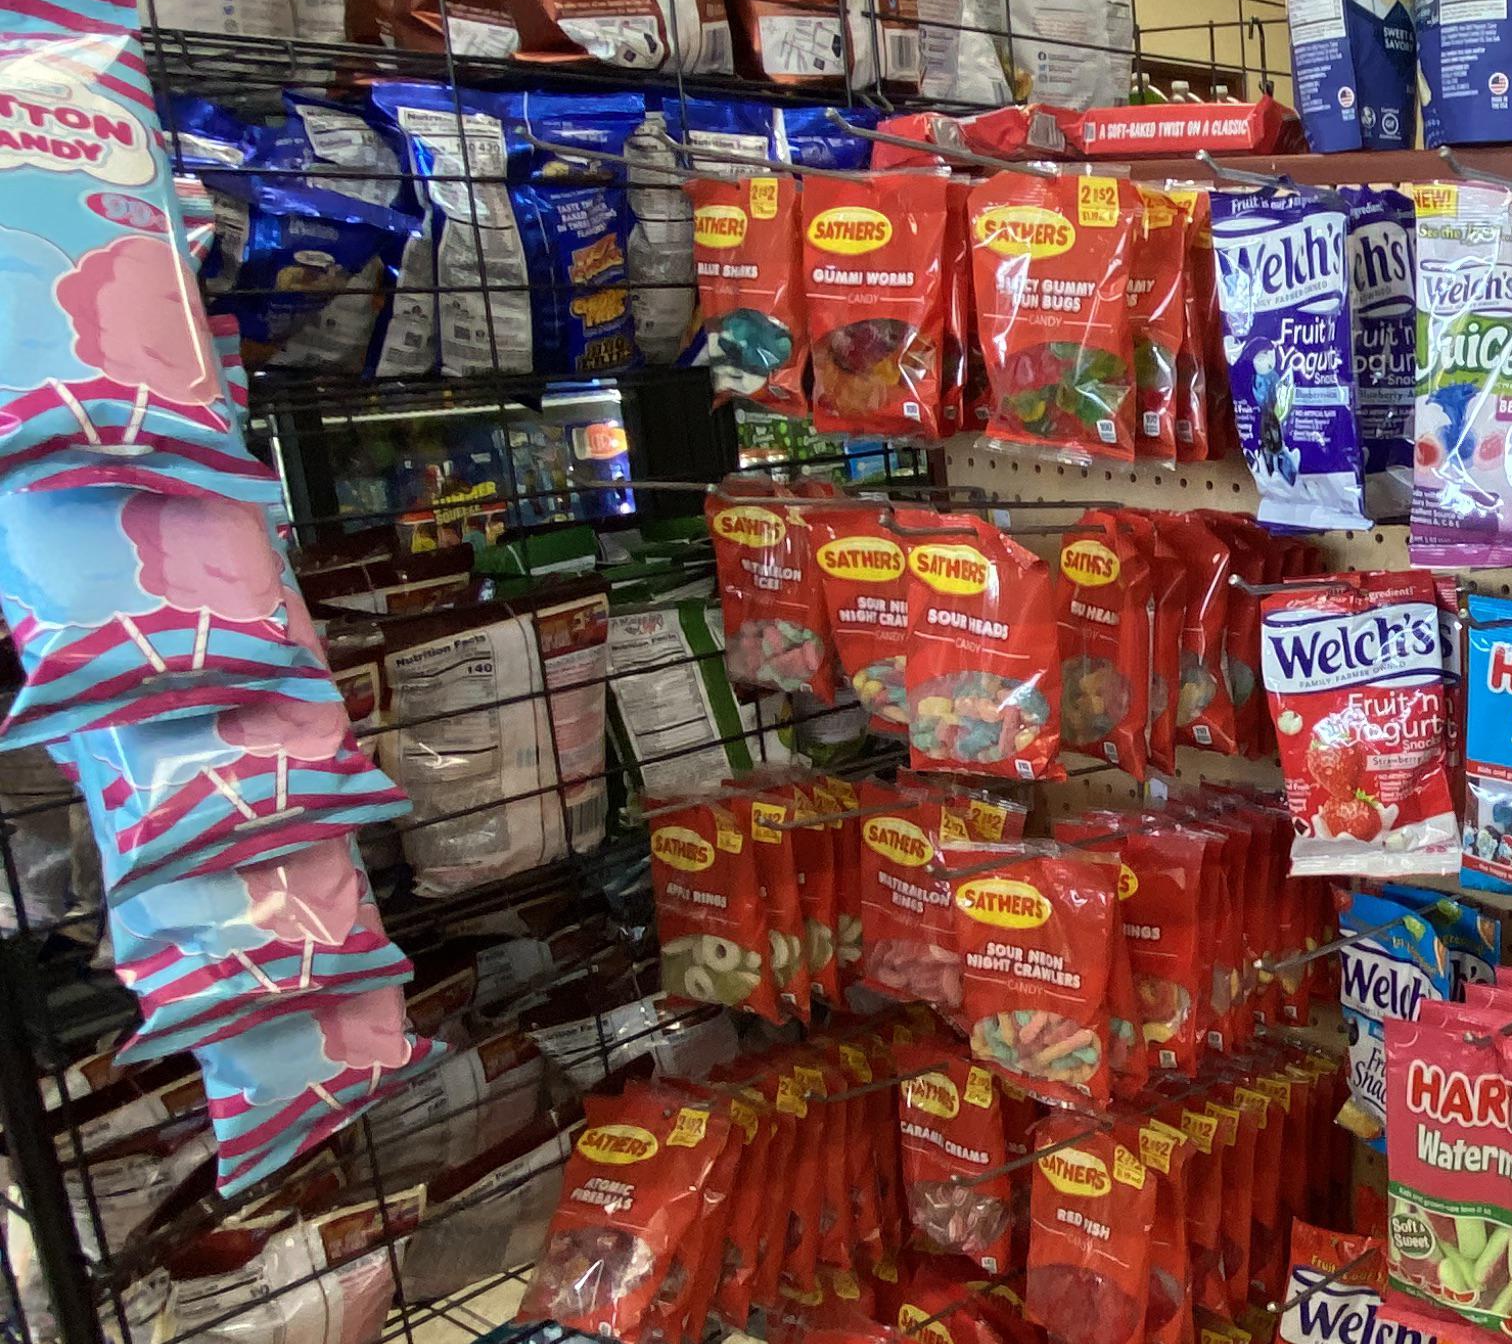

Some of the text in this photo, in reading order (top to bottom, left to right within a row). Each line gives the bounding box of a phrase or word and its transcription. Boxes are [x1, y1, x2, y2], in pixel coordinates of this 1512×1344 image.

[1159, 123, 1186, 137] TWIST
[1188, 122, 1201, 137] ON
[1212, 120, 1248, 136] CLASSIC
[1413, 191, 1451, 211] NEW!
[814, 219, 886, 242] SATHERS
[983, 216, 1070, 249] SATHERS
[1218, 221, 1343, 298] Welch's
[823, 548, 902, 572] SATHERS
[914, 553, 989, 586] SATHERS
[928, 609, 1009, 640] SOUR HEADS
[1269, 613, 1436, 681] Welch's
[868, 826, 928, 859] SATHERS
[963, 888, 1048, 920] SATHERS
[966, 953, 1081, 990] NIGHT CRAWLERS
[986, 942, 1064, 970] SOUR NEON
[1039, 1154, 1108, 1190] SATHERS
[1392, 1218, 1419, 1234] Soft
[1392, 1231, 1430, 1249] Sweet
